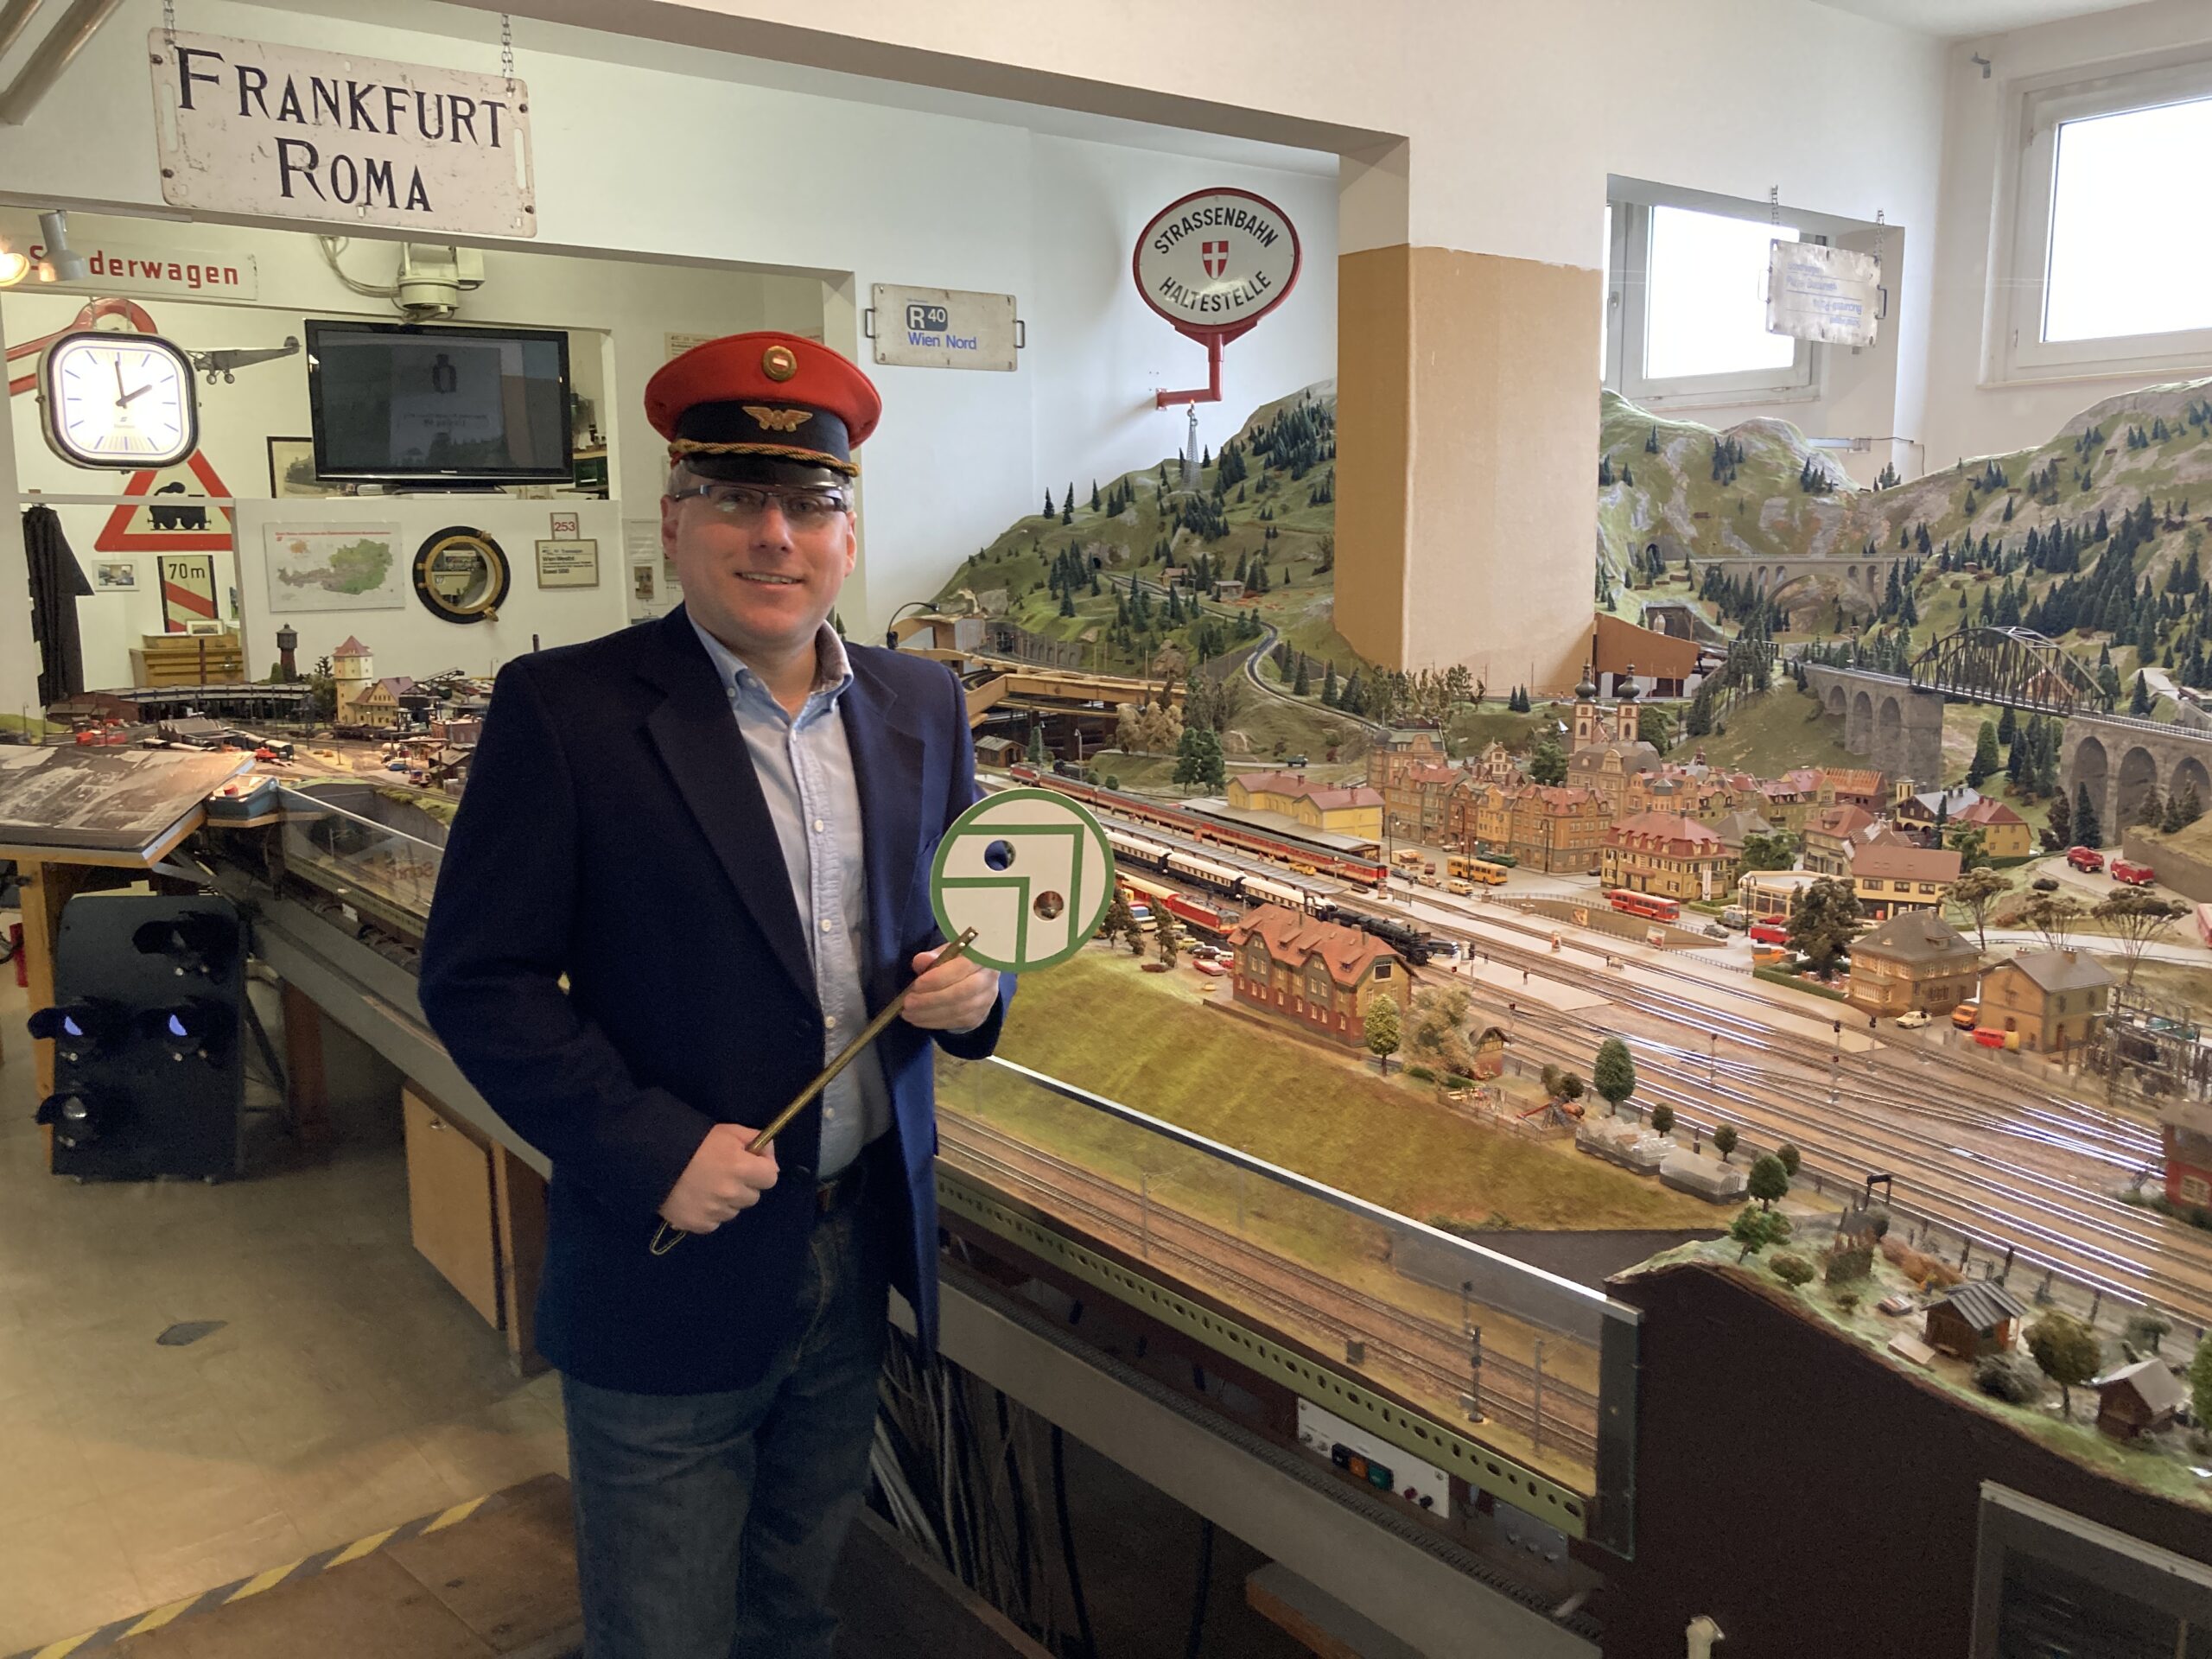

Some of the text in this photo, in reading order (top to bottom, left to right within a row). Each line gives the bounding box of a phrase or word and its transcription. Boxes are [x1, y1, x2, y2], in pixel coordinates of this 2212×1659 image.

[175, 46, 507, 148] FRANKFURT
[275, 137, 433, 213] ROMA
[1154, 207, 1279, 254] STRASSENBAHN
[29, 245, 239, 289] Sderwagen
[1160, 270, 1271, 312] HALTESTELLE
[910, 307, 946, 328] R 40
[908, 332, 976, 350] Wien Nord
[554, 521, 575, 531] 253
